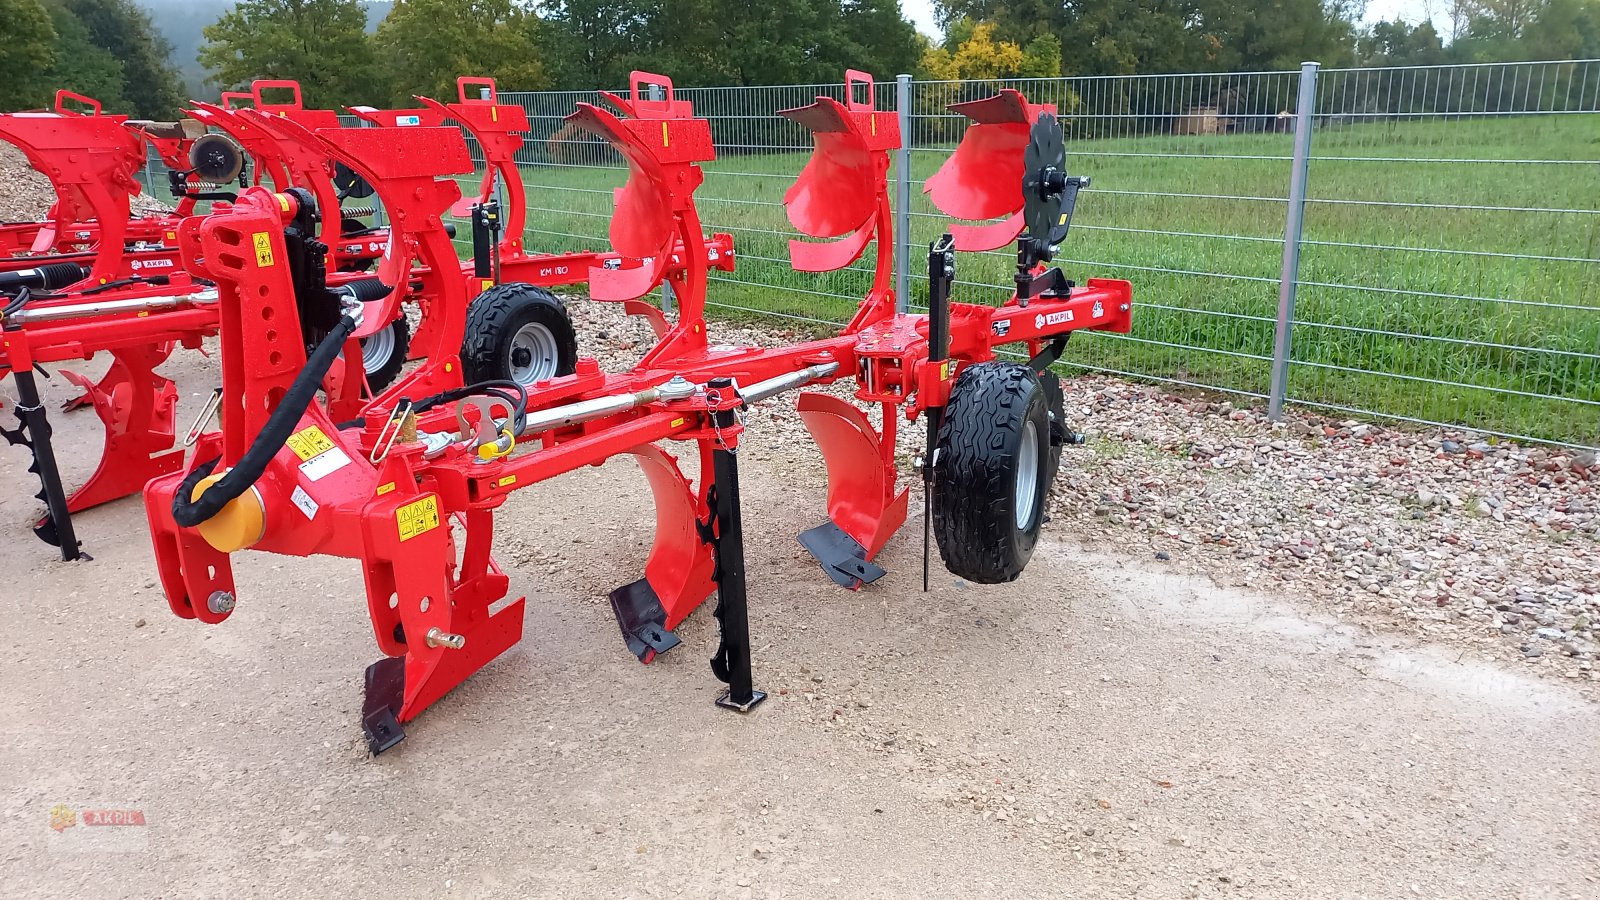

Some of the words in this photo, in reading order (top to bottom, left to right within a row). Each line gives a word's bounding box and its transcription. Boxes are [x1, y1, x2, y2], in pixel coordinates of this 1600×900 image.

[540, 268, 552, 277] KM
[554, 266, 569, 275] 180
[1049, 312, 1071, 323] AKPIL
